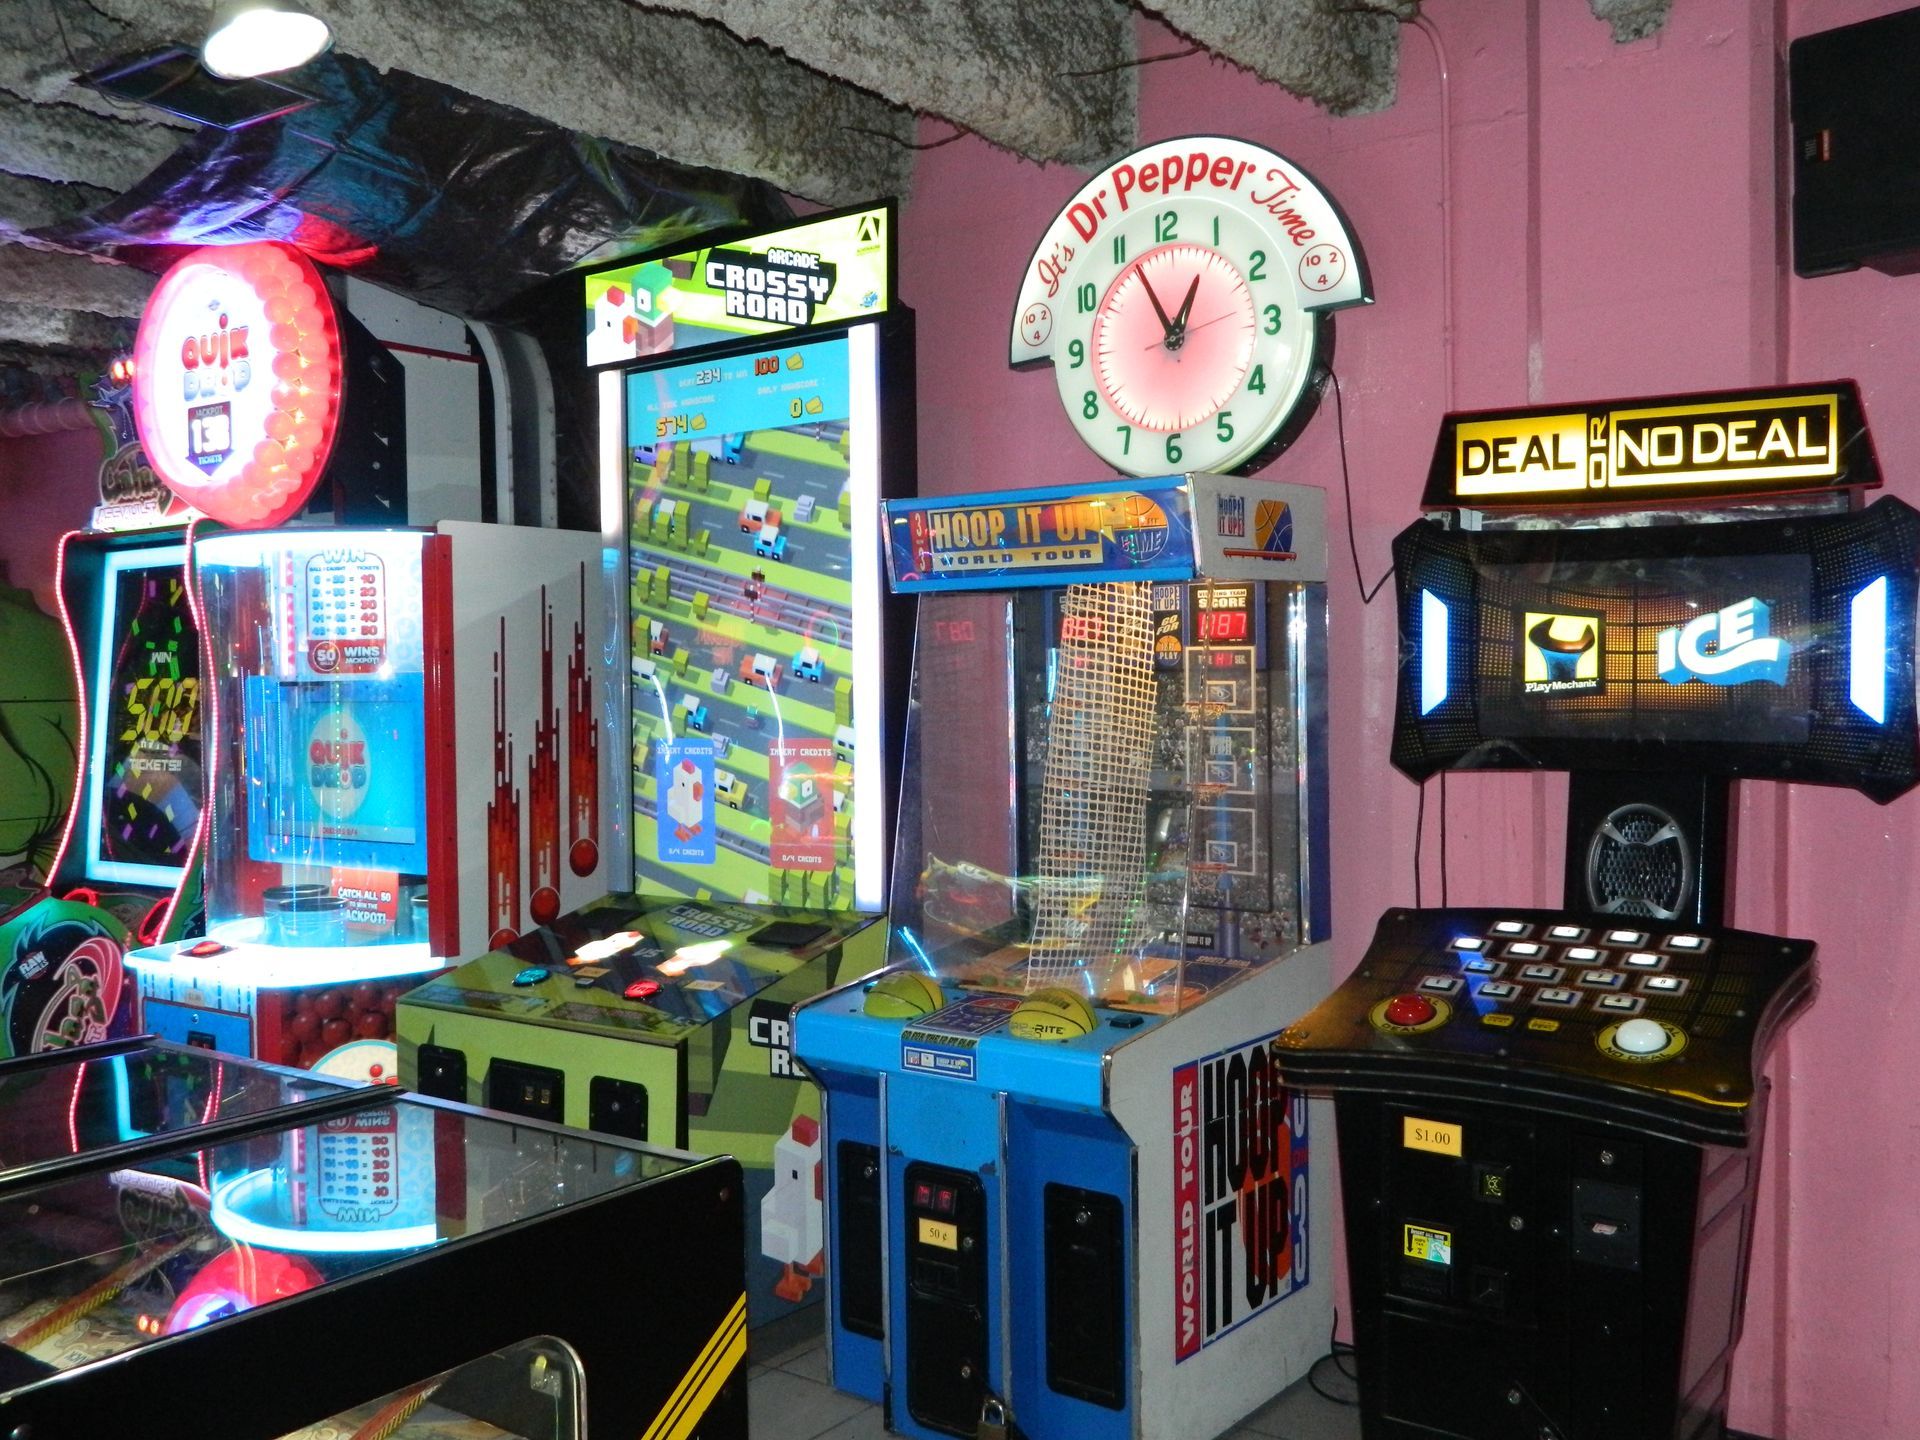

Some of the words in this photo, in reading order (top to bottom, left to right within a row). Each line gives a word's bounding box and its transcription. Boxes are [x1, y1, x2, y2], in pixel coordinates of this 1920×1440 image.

[1037, 243, 1074, 298] It's
[1066, 190, 1106, 243] Dr
[1112, 152, 1256, 211] Pepper
[1251, 168, 1315, 246] Time
[1154, 210, 1178, 243] 12
[1213, 216, 1220, 246] 1
[767, 248, 820, 270] ARCADE
[1113, 235, 1126, 264] 11
[1306, 254, 1321, 267] 10
[1329, 251, 1338, 264] 2
[1249, 251, 1266, 281] 2
[1318, 273, 1329, 286] 4
[706, 261, 829, 302] CROSSY
[726, 290, 809, 325] ROAD
[1077, 283, 1097, 313] 10
[1025, 313, 1036, 325] 10
[1040, 310, 1047, 320] 2
[1263, 304, 1281, 335] 3
[1033, 330, 1041, 340] 4
[1068, 339, 1084, 368] 9
[696, 367, 721, 385] 234
[754, 355, 779, 376] 100
[1247, 364, 1266, 395] 4
[789, 397, 803, 418] 0
[1083, 390, 1099, 419] 8
[656, 414, 688, 437] 574
[1217, 411, 1234, 442] 5
[1117, 426, 1132, 455] 7
[1166, 433, 1183, 464] 6
[1462, 433, 1576, 477] DEAL
[1589, 415, 1607, 488] OR
[1617, 426, 1682, 469] NO
[1692, 417, 1827, 465] DEAL
[933, 509, 1006, 549] HOOP
[1017, 506, 1042, 544] IT
[941, 553, 1014, 566] WORLD
[1032, 549, 1092, 562] TOUR
[1156, 621, 1180, 635] FOR
[1161, 615, 1178, 625] GO
[344, 646, 380, 657] WINS
[1657, 598, 1784, 682] ICE
[151, 651, 172, 664] WIN
[316, 649, 336, 661] 50
[798, 748, 832, 757] CREDITS
[380, 891, 391, 902] 50
[346, 909, 386, 925] ACKPOT!
[665, 915, 725, 937] ROAD
[668, 904, 753, 933] CROSSY
[19, 950, 46, 976] RAW
[1181, 1081, 1194, 1192] TOUR
[1415, 1128, 1451, 1145] $1.00
[929, 1227, 940, 1239] 50
[1183, 1199, 1196, 1348] WORLD
[1205, 1197, 1238, 1338] IT
